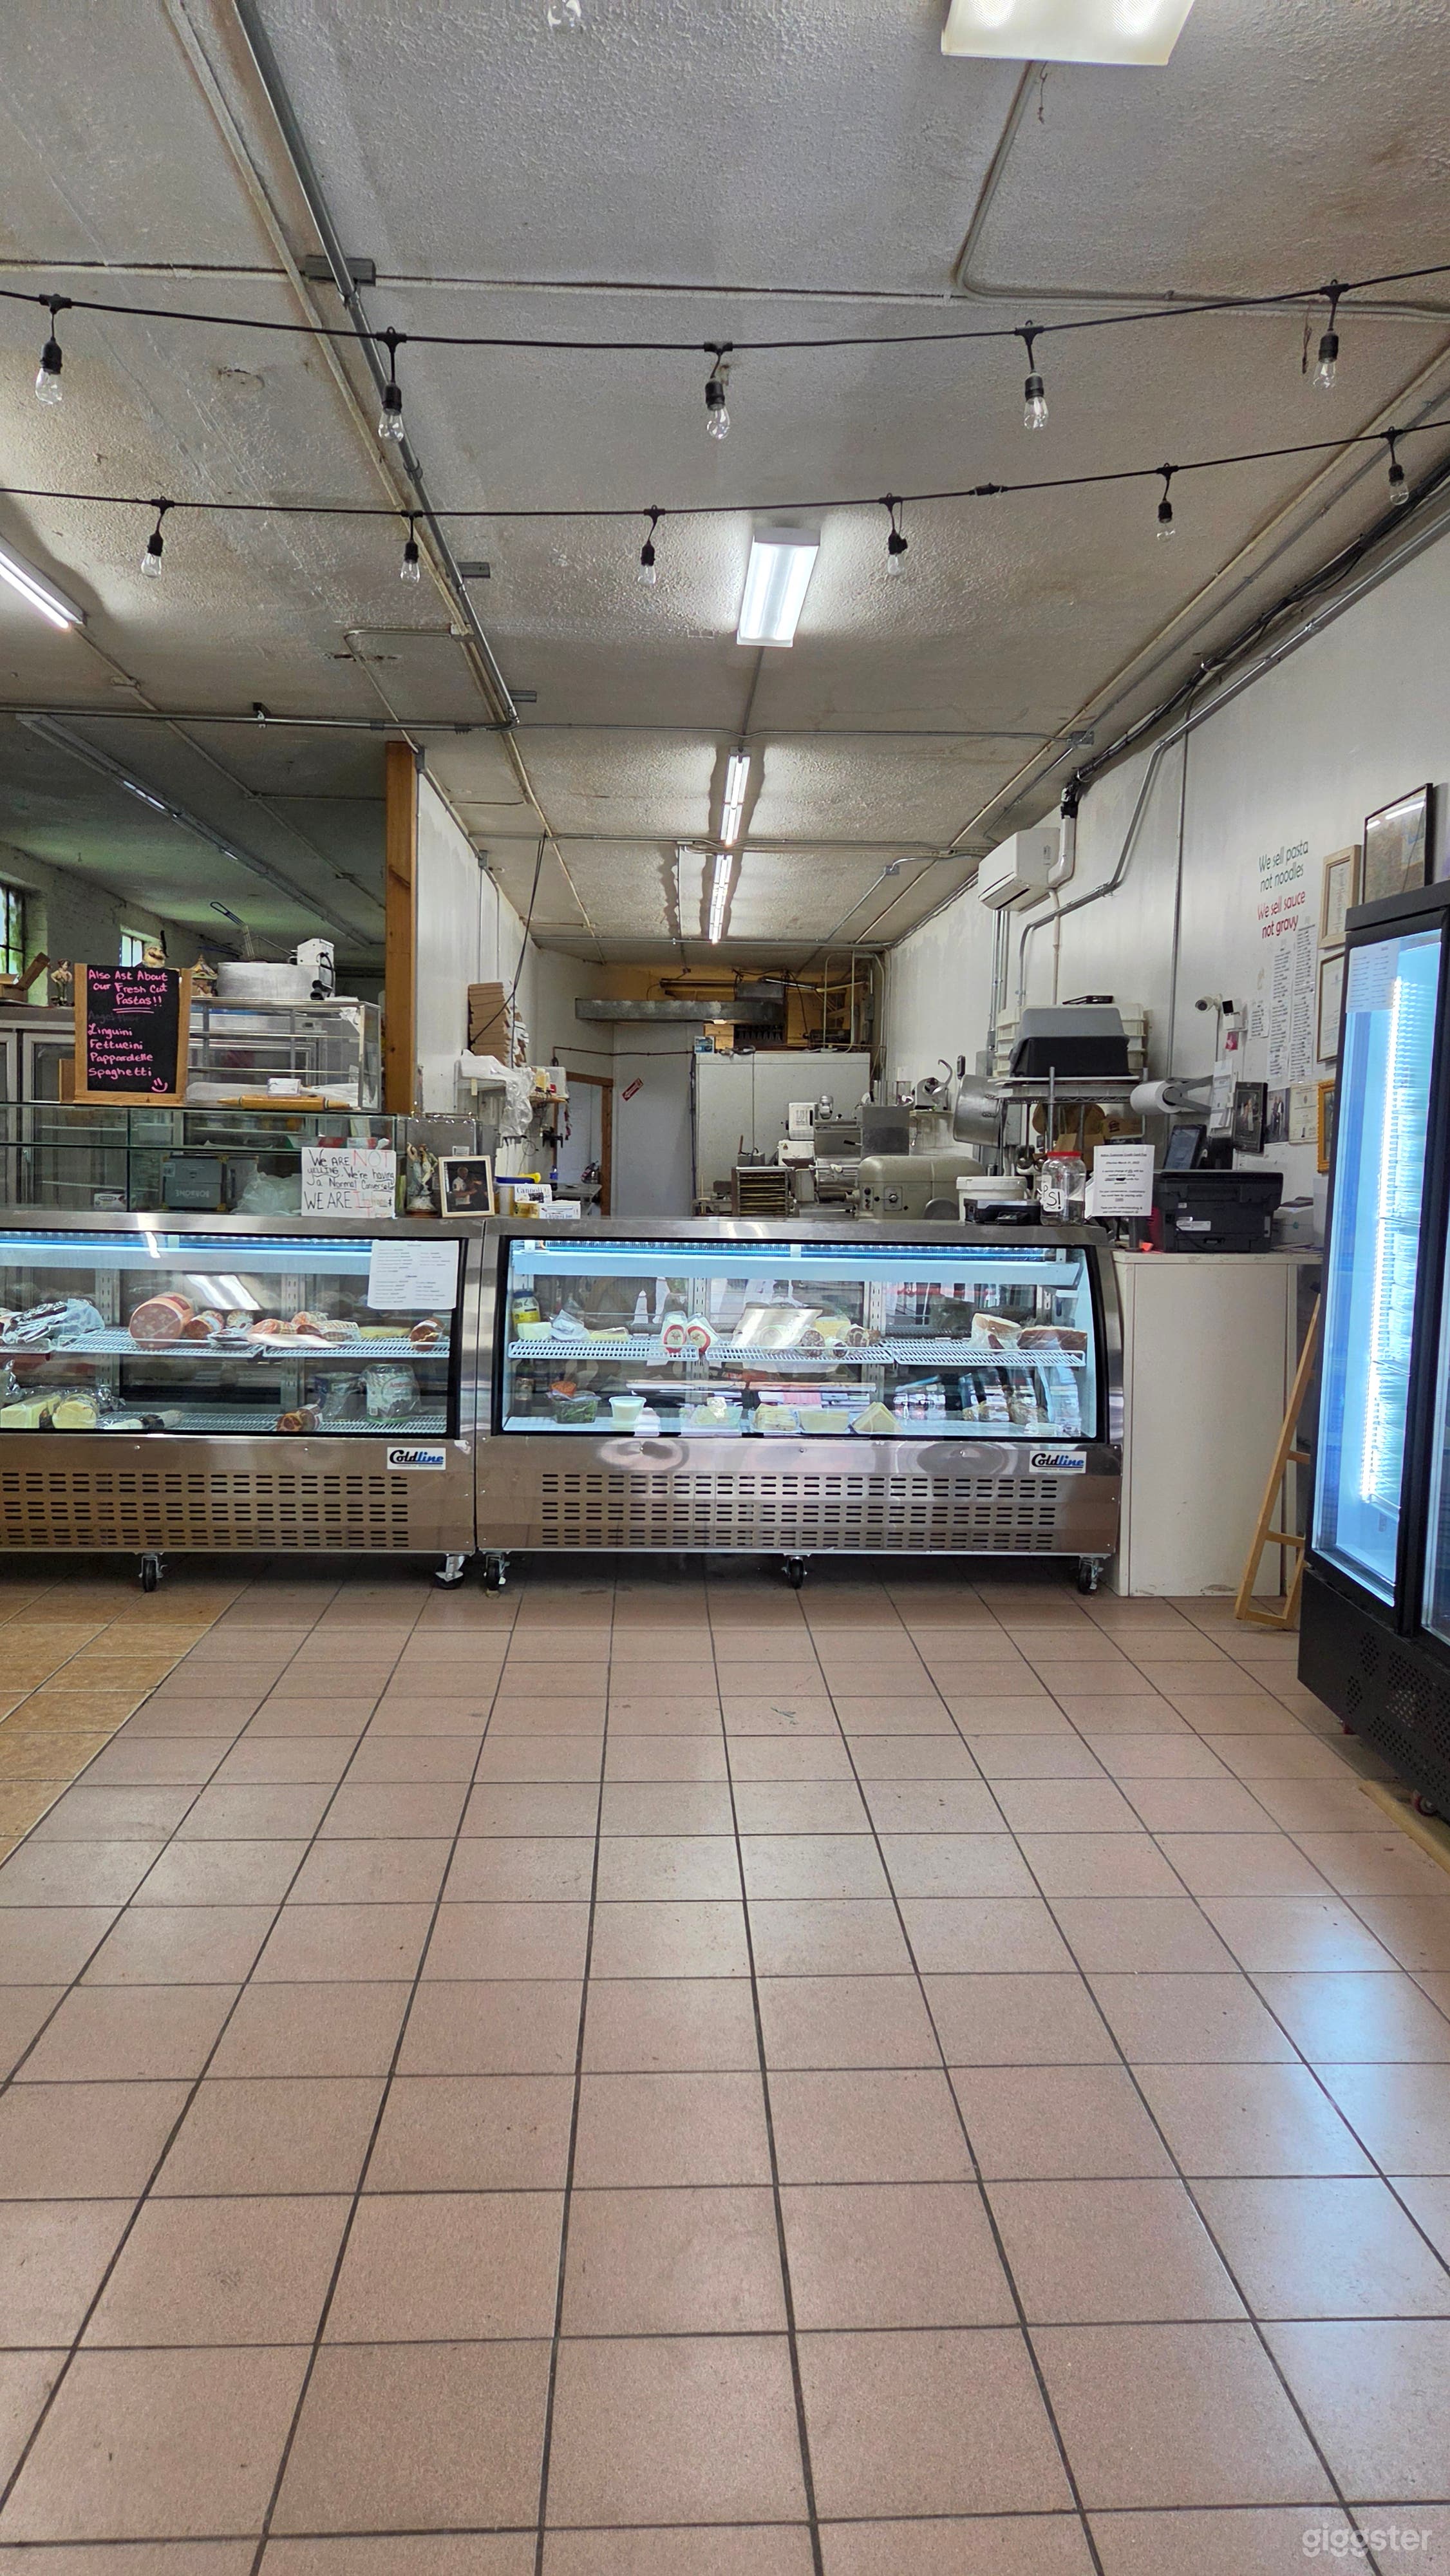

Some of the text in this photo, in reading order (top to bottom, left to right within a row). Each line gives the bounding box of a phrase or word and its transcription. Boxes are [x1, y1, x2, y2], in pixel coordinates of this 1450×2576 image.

[1259, 840, 1308, 873] We sell pasta
[1260, 862, 1304, 892] not noodles
[1257, 891, 1306, 920] We sell sauce
[1262, 915, 1299, 938] not gravy
[89, 969, 168, 981] Also Ask About
[114, 982, 146, 993] Fresh
[149, 983, 167, 993] Cut
[116, 992, 162, 1007] Pastas!!
[88, 1023, 133, 1039] Linguini
[90, 1039, 143, 1050] Fettucini
[88, 1067, 152, 1079] Spaghetti
[308, 1149, 392, 1168] We ARE NOT
[304, 1191, 324, 1209] WE
[327, 1191, 352, 1209] ARE
[390, 1450, 444, 1465] Coldline
[1031, 1453, 1084, 1468] Coldline
